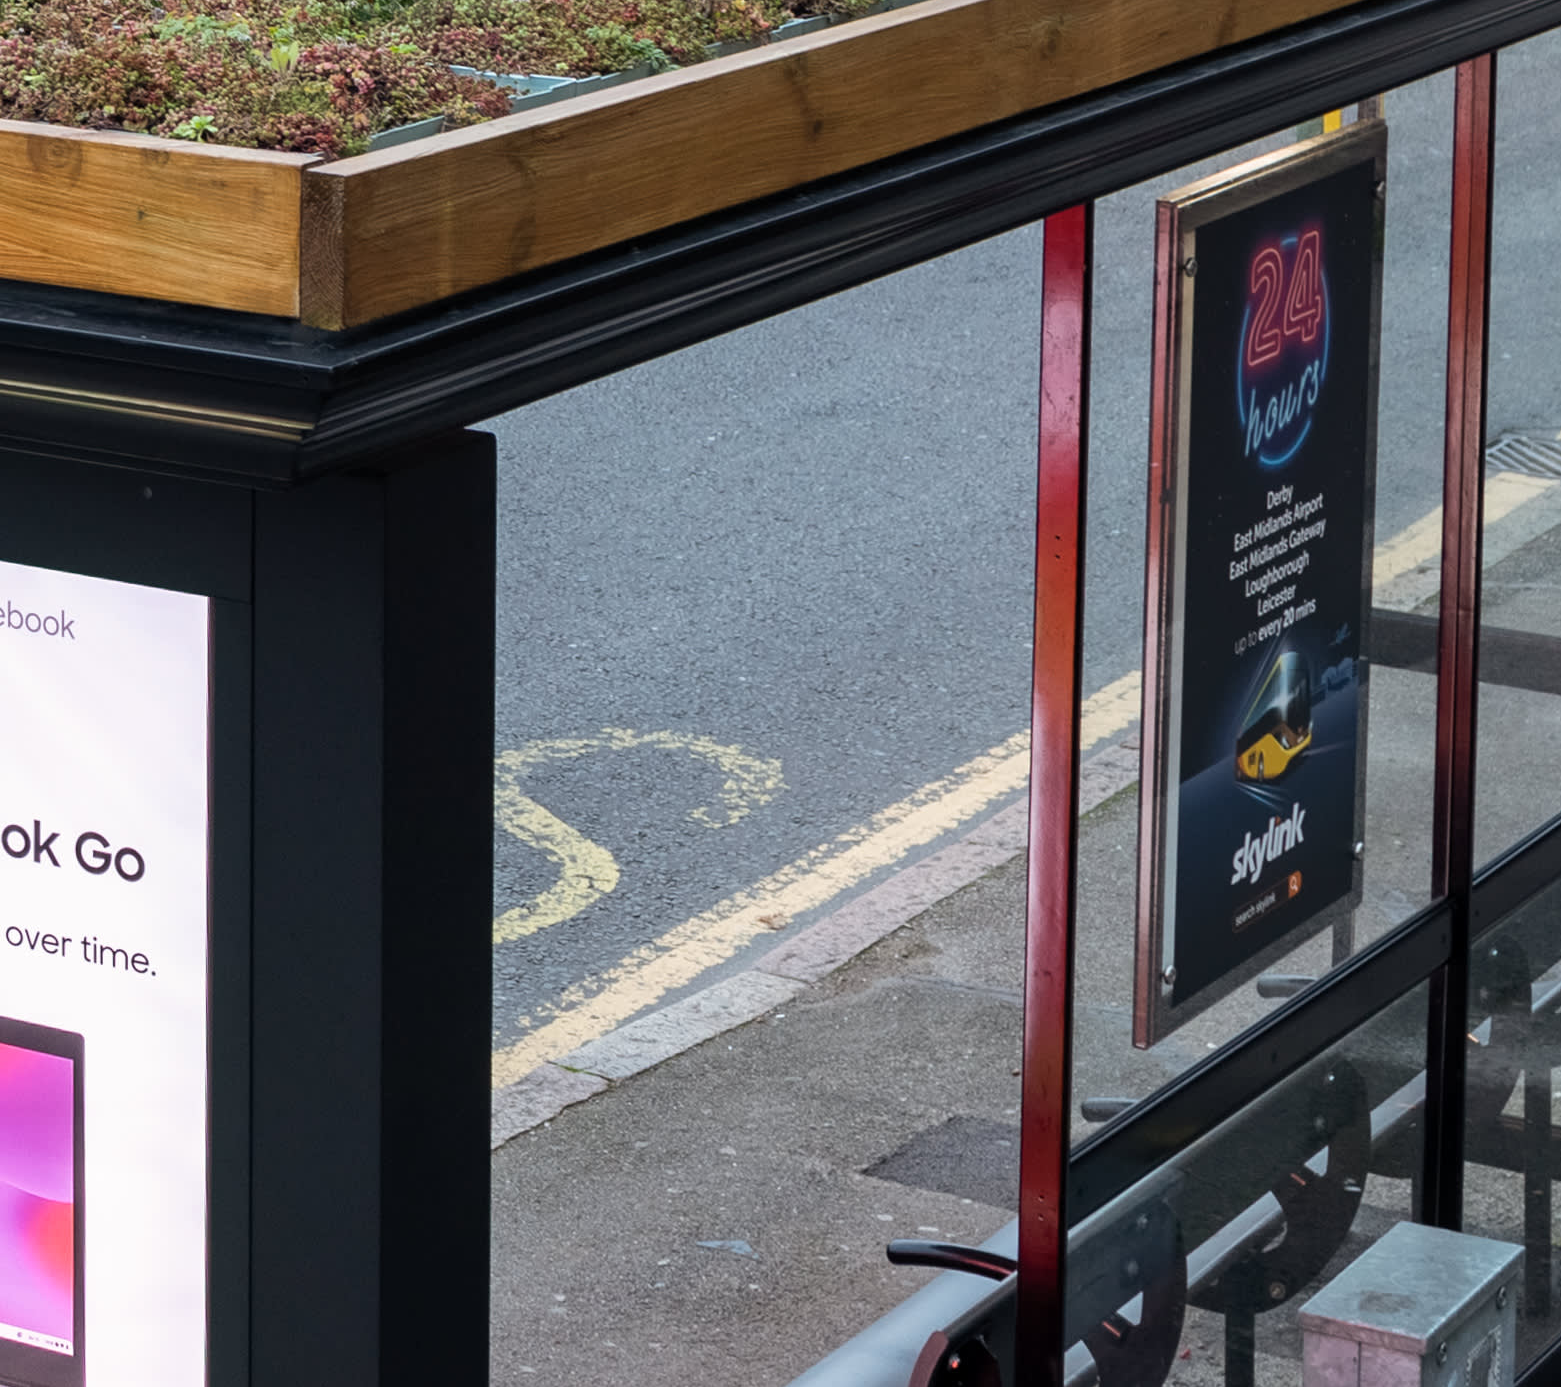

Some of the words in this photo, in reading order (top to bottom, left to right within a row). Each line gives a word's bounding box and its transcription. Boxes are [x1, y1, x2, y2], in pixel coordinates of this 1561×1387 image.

[1248, 230, 1321, 366] 24
[1245, 359, 1320, 457] hours
[1233, 528, 1253, 553] East
[1254, 508, 1293, 543] Midlands
[1293, 493, 1323, 521] Airport
[1266, 485, 1294, 510] Derby
[1229, 558, 1248, 581] East
[1249, 536, 1288, 571] Midlands
[1289, 518, 1327, 549] Gateway
[1245, 550, 1310, 598] Loughborough
[1234, 637, 1247, 657] up
[1247, 631, 1258, 648] to
[1258, 616, 1283, 641] every
[1283, 605, 1295, 629] 20
[1295, 598, 1317, 621] mins
[1257, 584, 1296, 617] Leicester
[75, 830, 146, 883] Go
[1230, 801, 1306, 886] skylink
[1235, 907, 1256, 927] search
[1255, 891, 1277, 913] skylink
[5, 925, 74, 960] over
[80, 936, 157, 978] time.
